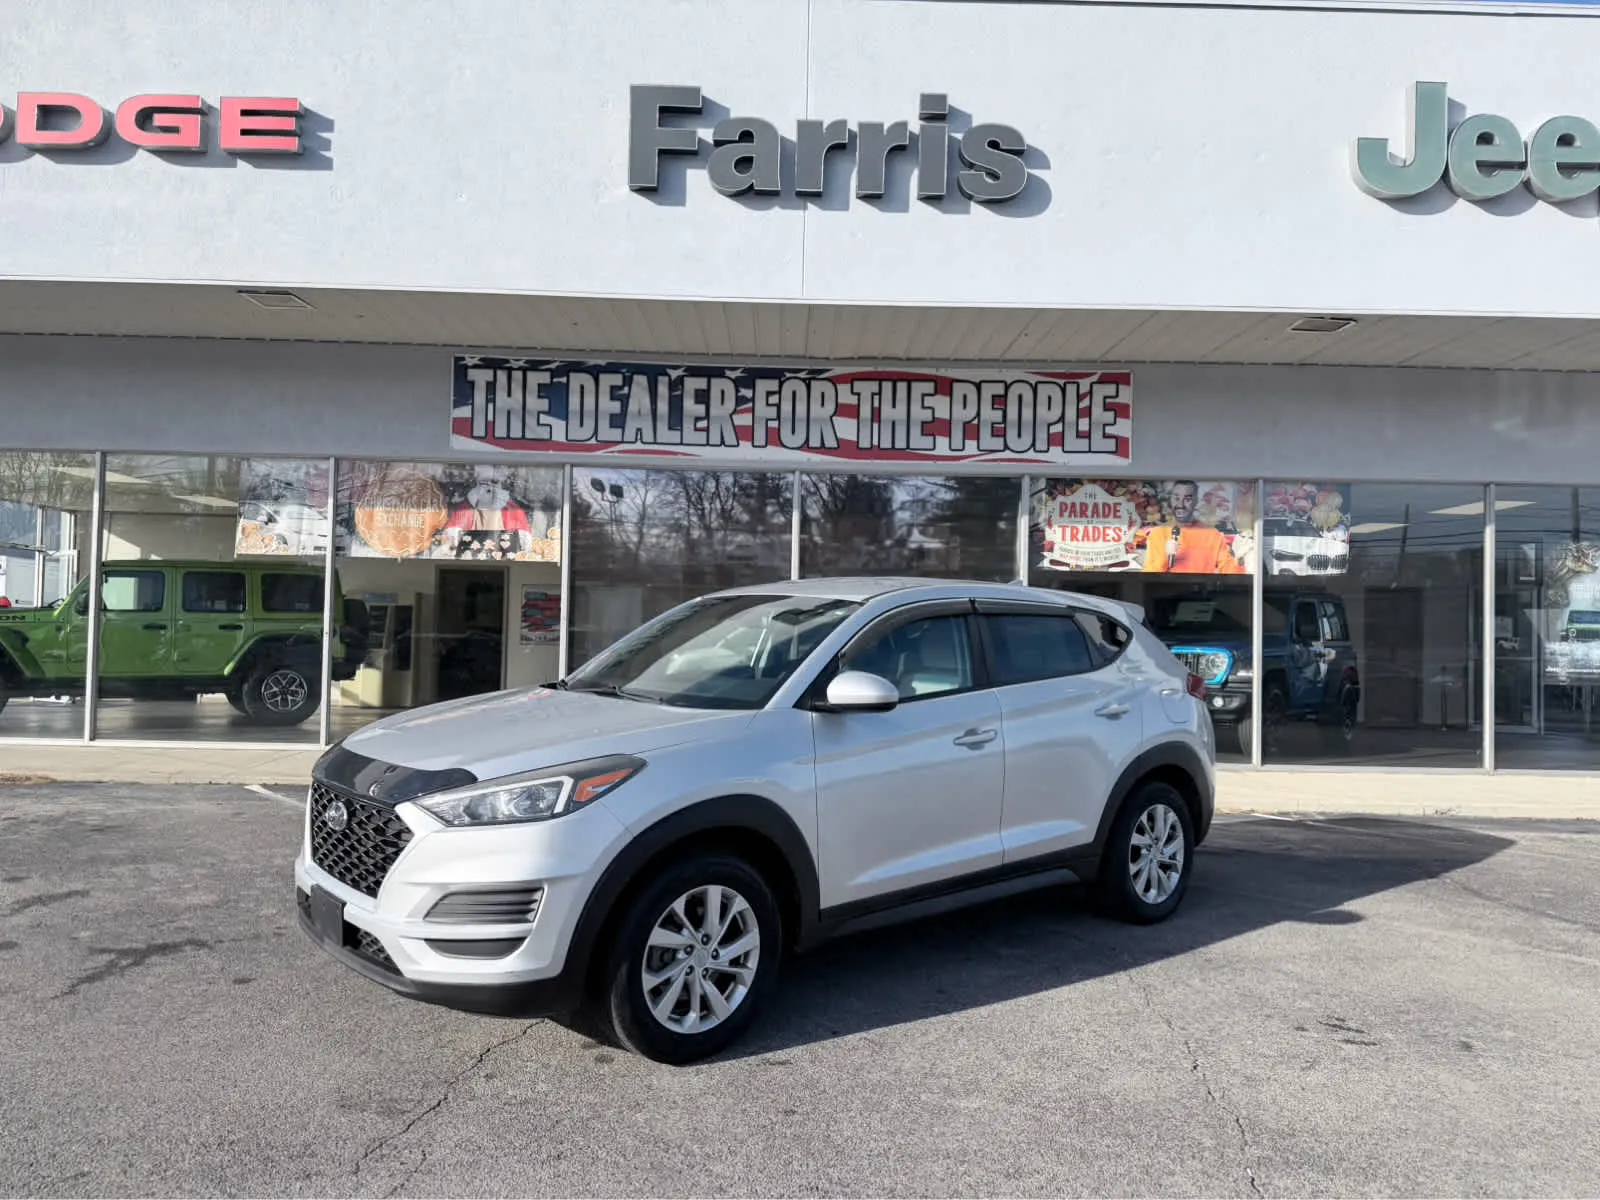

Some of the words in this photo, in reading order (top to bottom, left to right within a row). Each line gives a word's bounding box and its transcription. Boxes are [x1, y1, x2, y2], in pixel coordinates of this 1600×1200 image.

[0, 92, 300, 150] DGE
[628, 84, 1028, 200] Farris
[1354, 81, 1600, 200] Jee
[466, 367, 552, 440] THE
[566, 370, 740, 447] DEALER
[752, 374, 840, 449] FOR
[851, 378, 939, 450] THE
[949, 379, 1119, 453] PEOPLE
[1058, 525, 1123, 543] TRADES
[1059, 502, 1122, 519] PARADE
